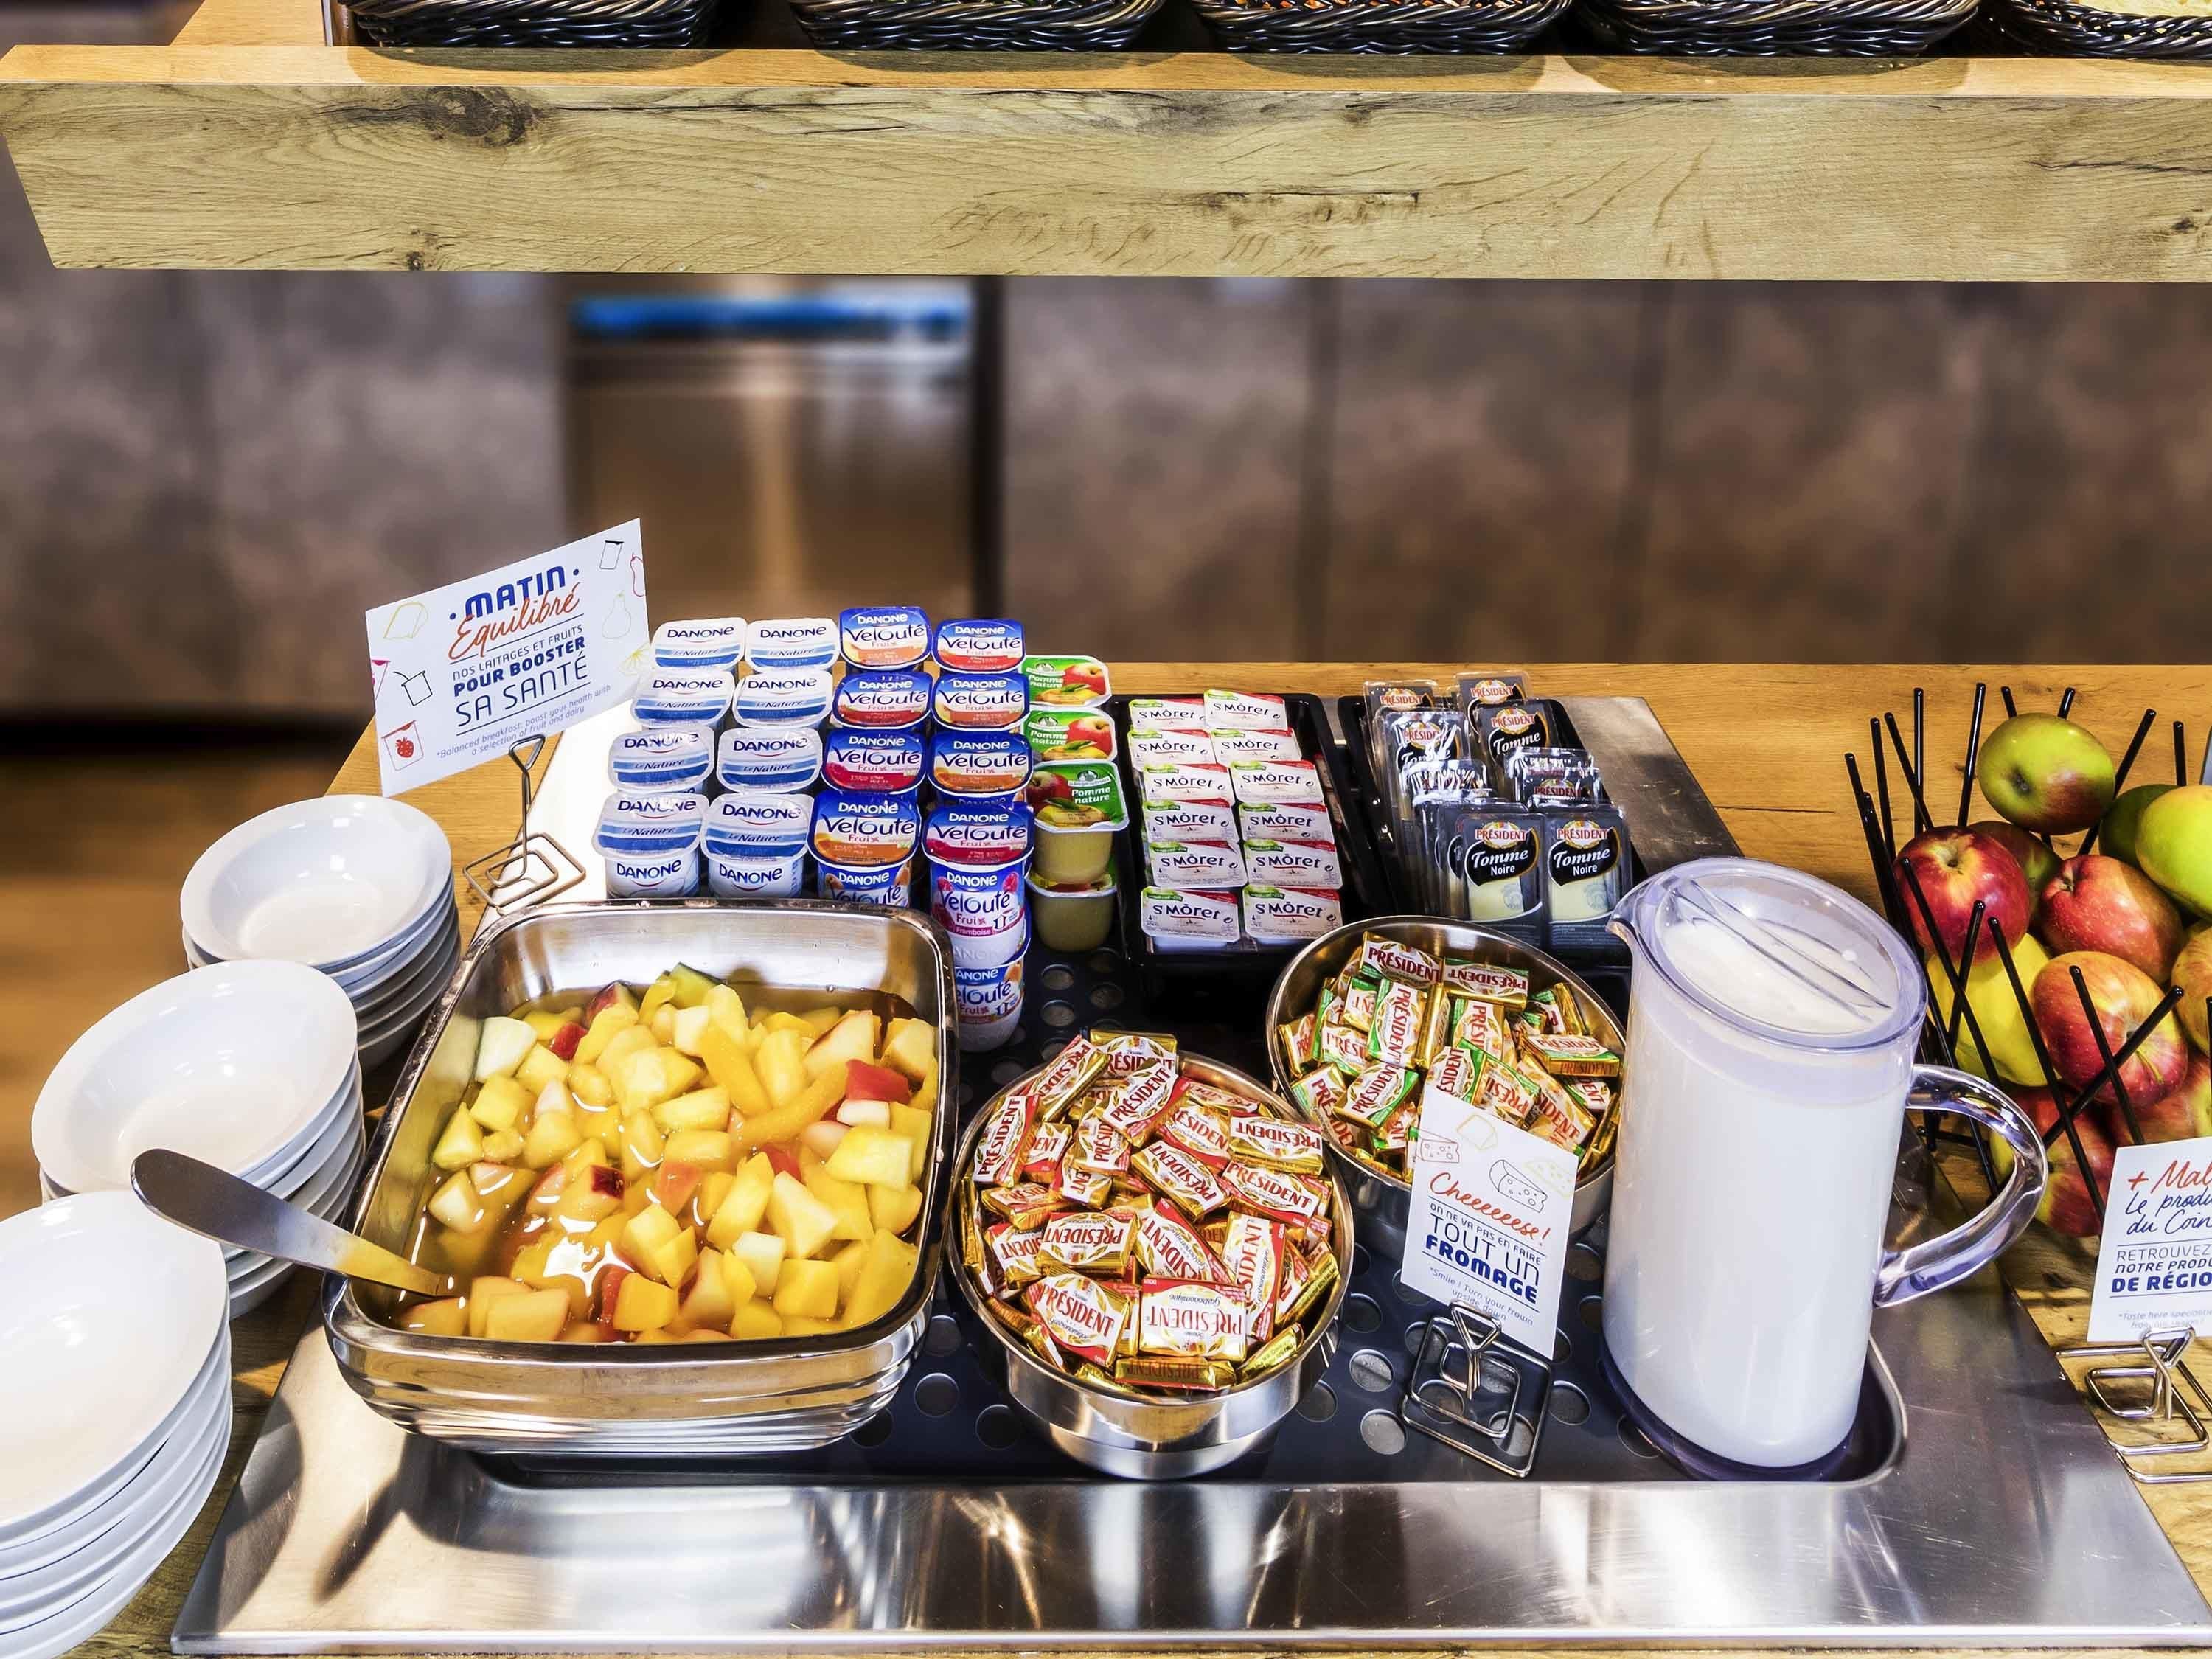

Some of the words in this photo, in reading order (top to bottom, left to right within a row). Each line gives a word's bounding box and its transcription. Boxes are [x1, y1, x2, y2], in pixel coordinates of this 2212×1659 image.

[465, 566, 566, 621] MATIN
[857, 613, 908, 625] DANONE
[667, 626, 734, 639] DANONE
[760, 626, 827, 639] DANONE
[844, 625, 925, 642] Velouté
[955, 626, 1006, 635] DANONE
[942, 634, 1021, 650] Velouté
[453, 666, 476, 681] NOS
[479, 646, 529, 671] LAITAGES
[533, 639, 544, 651] ET
[548, 625, 582, 645] FRUITS
[453, 669, 504, 697] POUR
[510, 636, 585, 677] BOOSTER
[653, 679, 723, 689] DANONE
[748, 678, 817, 689] DANONE
[859, 680, 914, 690] DANONE
[953, 680, 1007, 689] DANONE
[1028, 675, 1064, 683] Pomme
[456, 695, 491, 727] SA
[503, 651, 588, 710] SANTÉ
[843, 689, 927, 705] Velouté
[939, 689, 1023, 705] Velouté
[1470, 686, 1513, 697] PRÉSIDENT
[1380, 695, 1422, 704] PRÉSIDENT
[549, 705, 566, 717] your
[1492, 714, 1535, 728] PRÉSIDENT
[479, 734, 516, 754] selection
[549, 714, 563, 726] and
[849, 736, 906, 746] DANONE
[1031, 731, 1068, 740] Pomme
[1493, 731, 1541, 755] Tomme
[953, 740, 1010, 750] DANONE
[832, 745, 920, 765] Velouté
[938, 750, 1027, 768] Velouté
[1071, 787, 1110, 797] Pomme
[1074, 795, 1110, 804] nature
[838, 801, 898, 815] DANONE
[822, 815, 915, 835] Velouté
[949, 813, 1009, 822] DANONE
[933, 824, 1027, 841] Velouté
[1475, 829, 1527, 841] PRÉSIDENT
[1557, 829, 1609, 840] PRÉSIDENT
[1471, 849, 1528, 869] Tomme
[1553, 849, 1610, 869] Tomme
[616, 859, 682, 880] DANONE
[719, 863, 783, 884] DANONE
[1491, 865, 1515, 876] Noire
[1572, 865, 1598, 876] Noire
[838, 872, 890, 886] DANONE
[946, 871, 998, 887] DANONE
[939, 887, 1011, 914] Velouté
[956, 926, 992, 936] Framboise
[1368, 947, 1440, 982] PRÉSIDENT
[955, 968, 998, 980] ANONE
[1448, 969, 1526, 989] PRÉSIDENT
[956, 980, 1011, 1004] elouté
[1388, 988, 1411, 1062] PRÉSIDENT
[1326, 1032, 1364, 1058] PRÉSI
[1436, 1048, 1464, 1093] ÉSIDENT
[1110, 1067, 1172, 1122] PRÉSIDENT
[978, 1099, 1021, 1175] PRÉSIDENT
[1093, 1123, 1114, 1163] PRÉSID
[1237, 1121, 1321, 1150] PRÉSIDENT
[1149, 1145, 1217, 1201] PRÉSIDENT
[1226, 1162, 1312, 1209] PRÉSIDENT
[2125, 1191, 2147, 1215] Le
[2126, 1214, 2157, 1235] du
[1043, 1228, 1124, 1247] PRÉSIDENT
[1430, 1203, 1443, 1215] ON
[1447, 1211, 1458, 1222] NE
[1461, 1217, 1473, 1230] VA
[1476, 1225, 1495, 1241] PAS
[1498, 1237, 1510, 1248] EN
[1513, 1245, 1541, 1265] FAIRE
[1430, 1212, 1495, 1259] TOUT
[1506, 1251, 1540, 1286] UN
[2117, 1244, 2212, 1262] RETROUVEZ
[1425, 1234, 1537, 1304] FROMAGE
[2115, 1262, 2163, 1274] NOTRE
[2111, 1276, 2139, 1293] DE
[2146, 1271, 2212, 1290] RÉGIO
[1464, 1284, 1482, 1299] Turn
[1485, 1295, 1506, 1310] your
[1036, 1284, 1115, 1337] PRÉSIDENT
[1482, 1304, 1507, 1321] down
[1150, 1306, 1242, 1336] PRÉSIDENT
